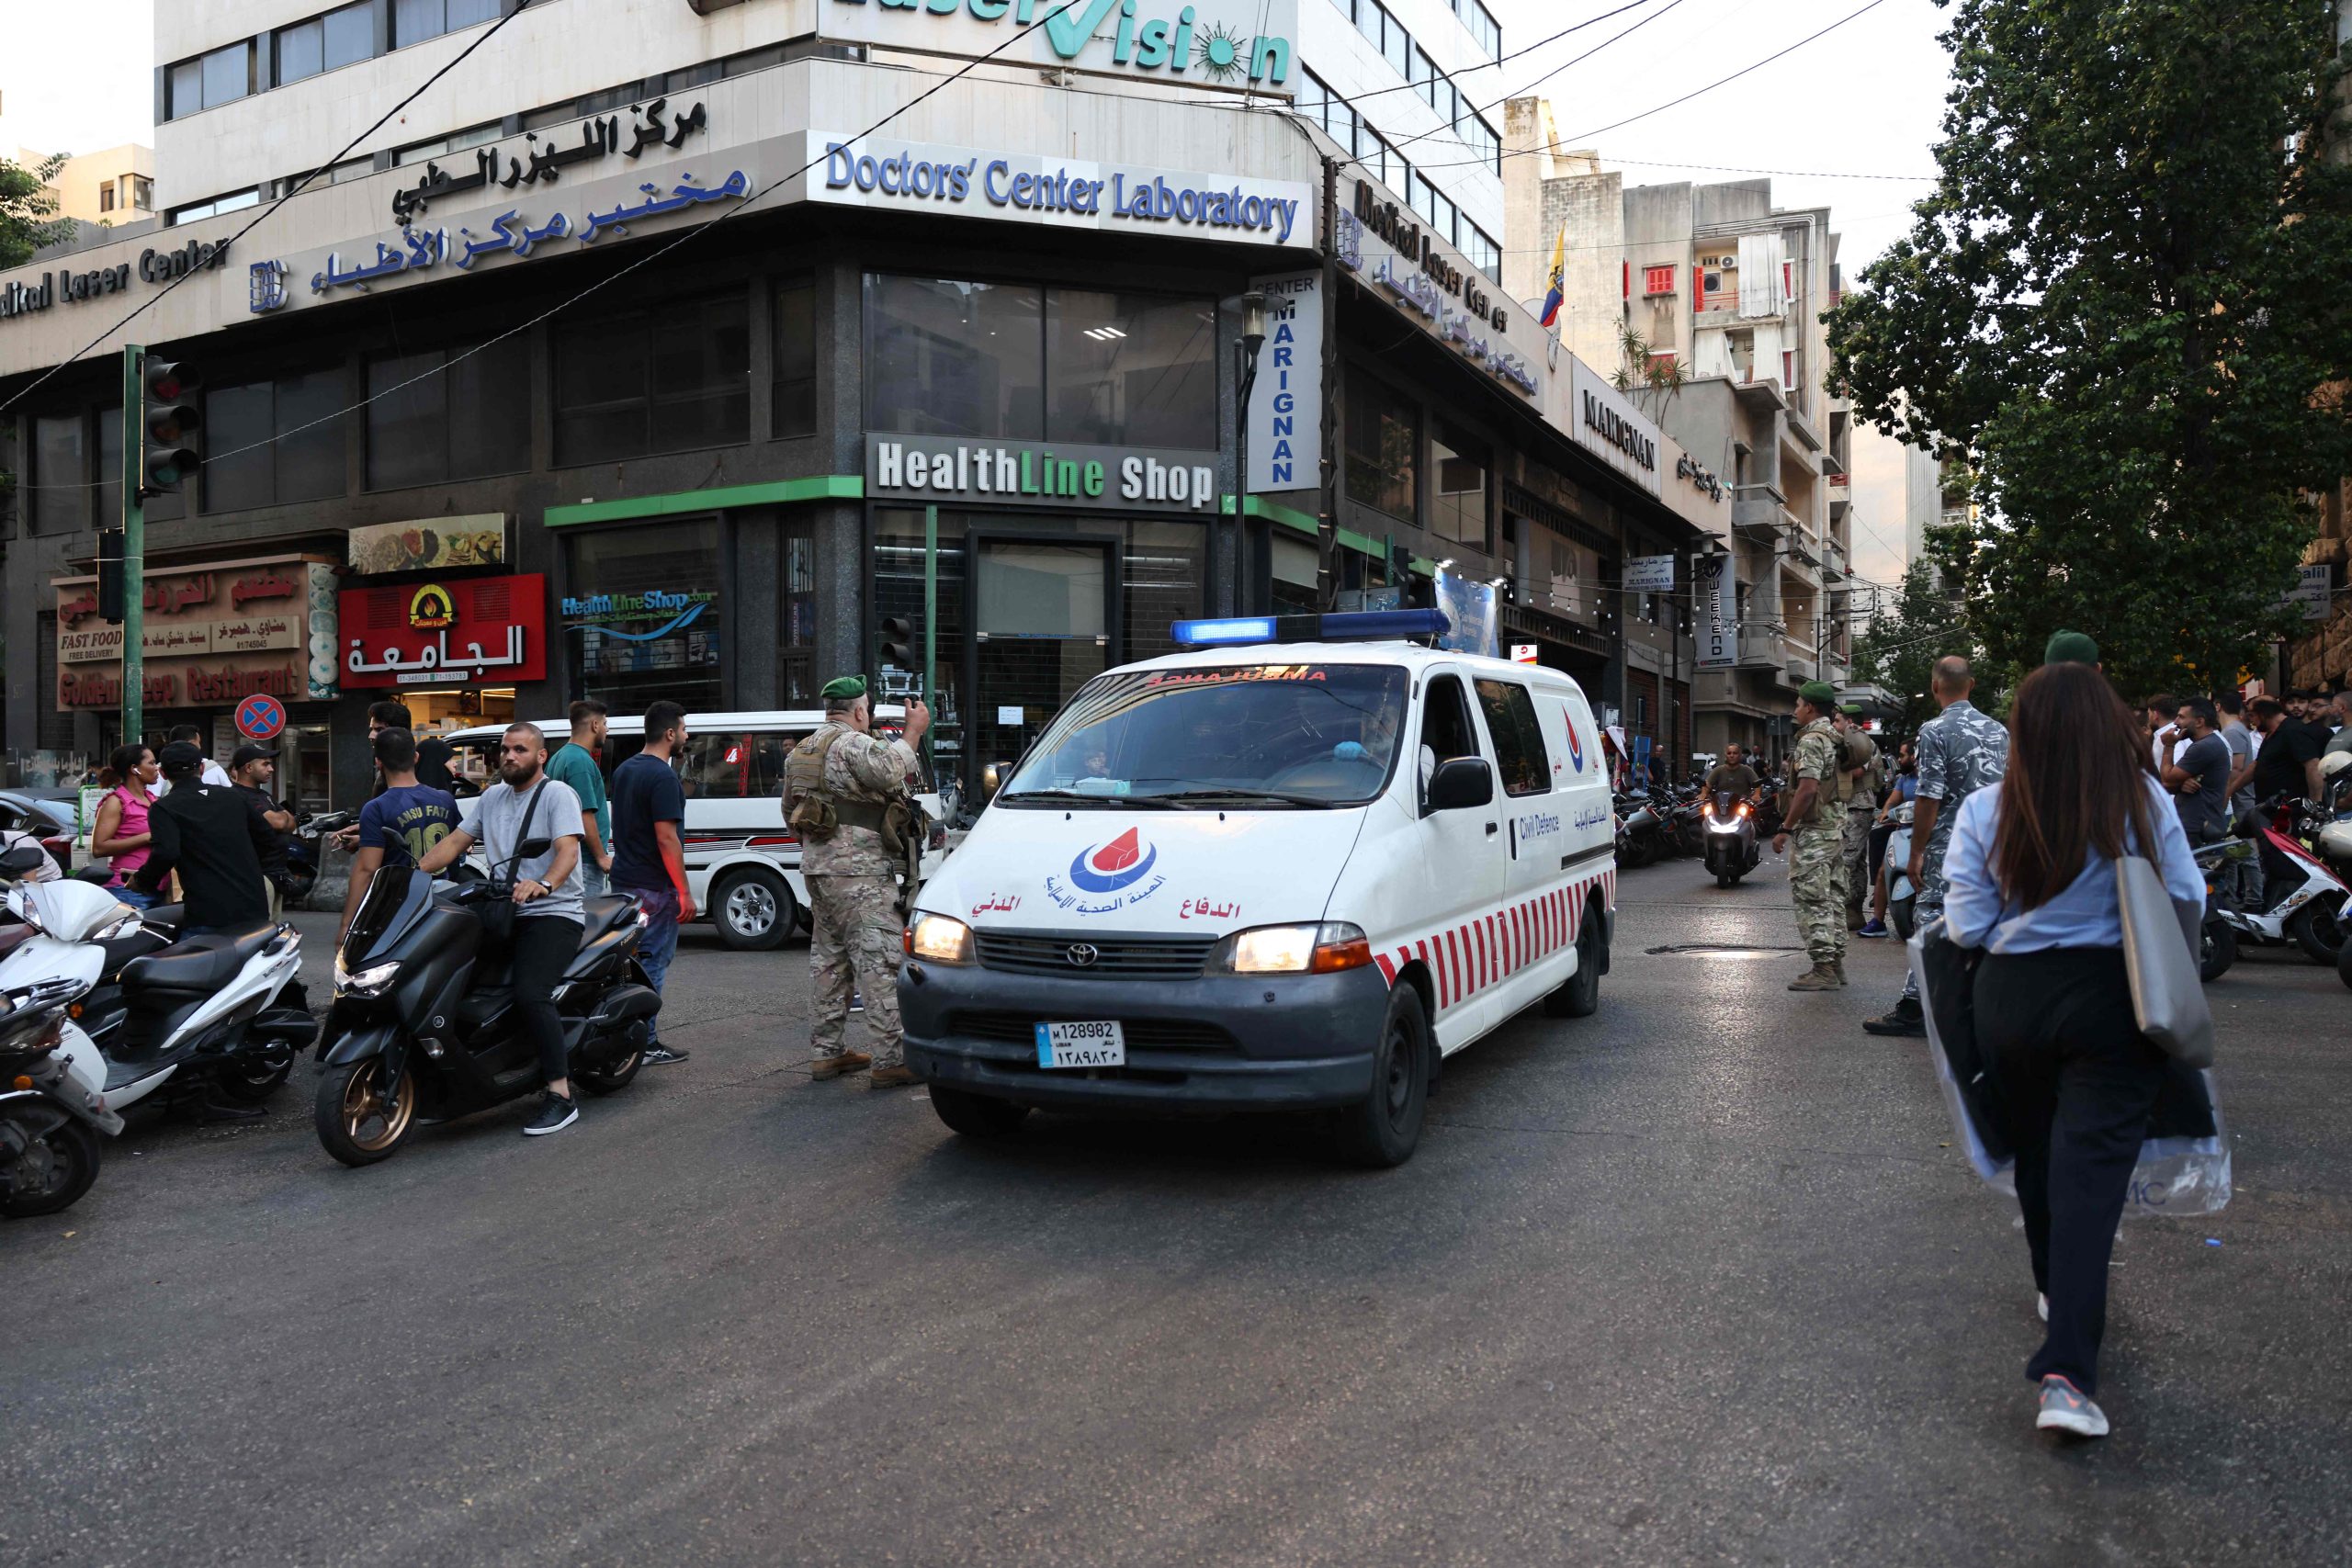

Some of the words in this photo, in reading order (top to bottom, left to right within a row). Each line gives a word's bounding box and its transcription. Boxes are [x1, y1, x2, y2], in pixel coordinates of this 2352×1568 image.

[623, 97, 707, 158] مركز
[392, 147, 498, 227] الطبي
[578, 170, 752, 243] مختبر
[826, 142, 978, 200] Doctors'
[985, 159, 1104, 214] Center
[1113, 173, 1298, 243] Laboratory
[456, 209, 573, 269] مركز
[0, 272, 52, 316] dical
[60, 263, 130, 303] Laser
[139, 237, 231, 283] Center
[1421, 235, 1464, 297] Laser
[1272, 299, 1296, 483] MARIGNAN
[1121, 457, 1213, 508] Shop
[2303, 567, 2325, 579] alil
[61, 633, 90, 649] FAST
[92, 630, 122, 647] FOOD
[69, 651, 85, 660] FREE
[85, 649, 114, 660] DELIVERY
[348, 626, 522, 675] الجامعة
[143, 673, 177, 706] eep
[187, 660, 298, 701] Restaurant
[397, 807, 423, 827] ANSU
[1520, 816, 1535, 840] Civil
[1535, 812, 1559, 836] Defence
[972, 892, 1022, 918] المدني
[1179, 897, 1241, 919] الدفاع
